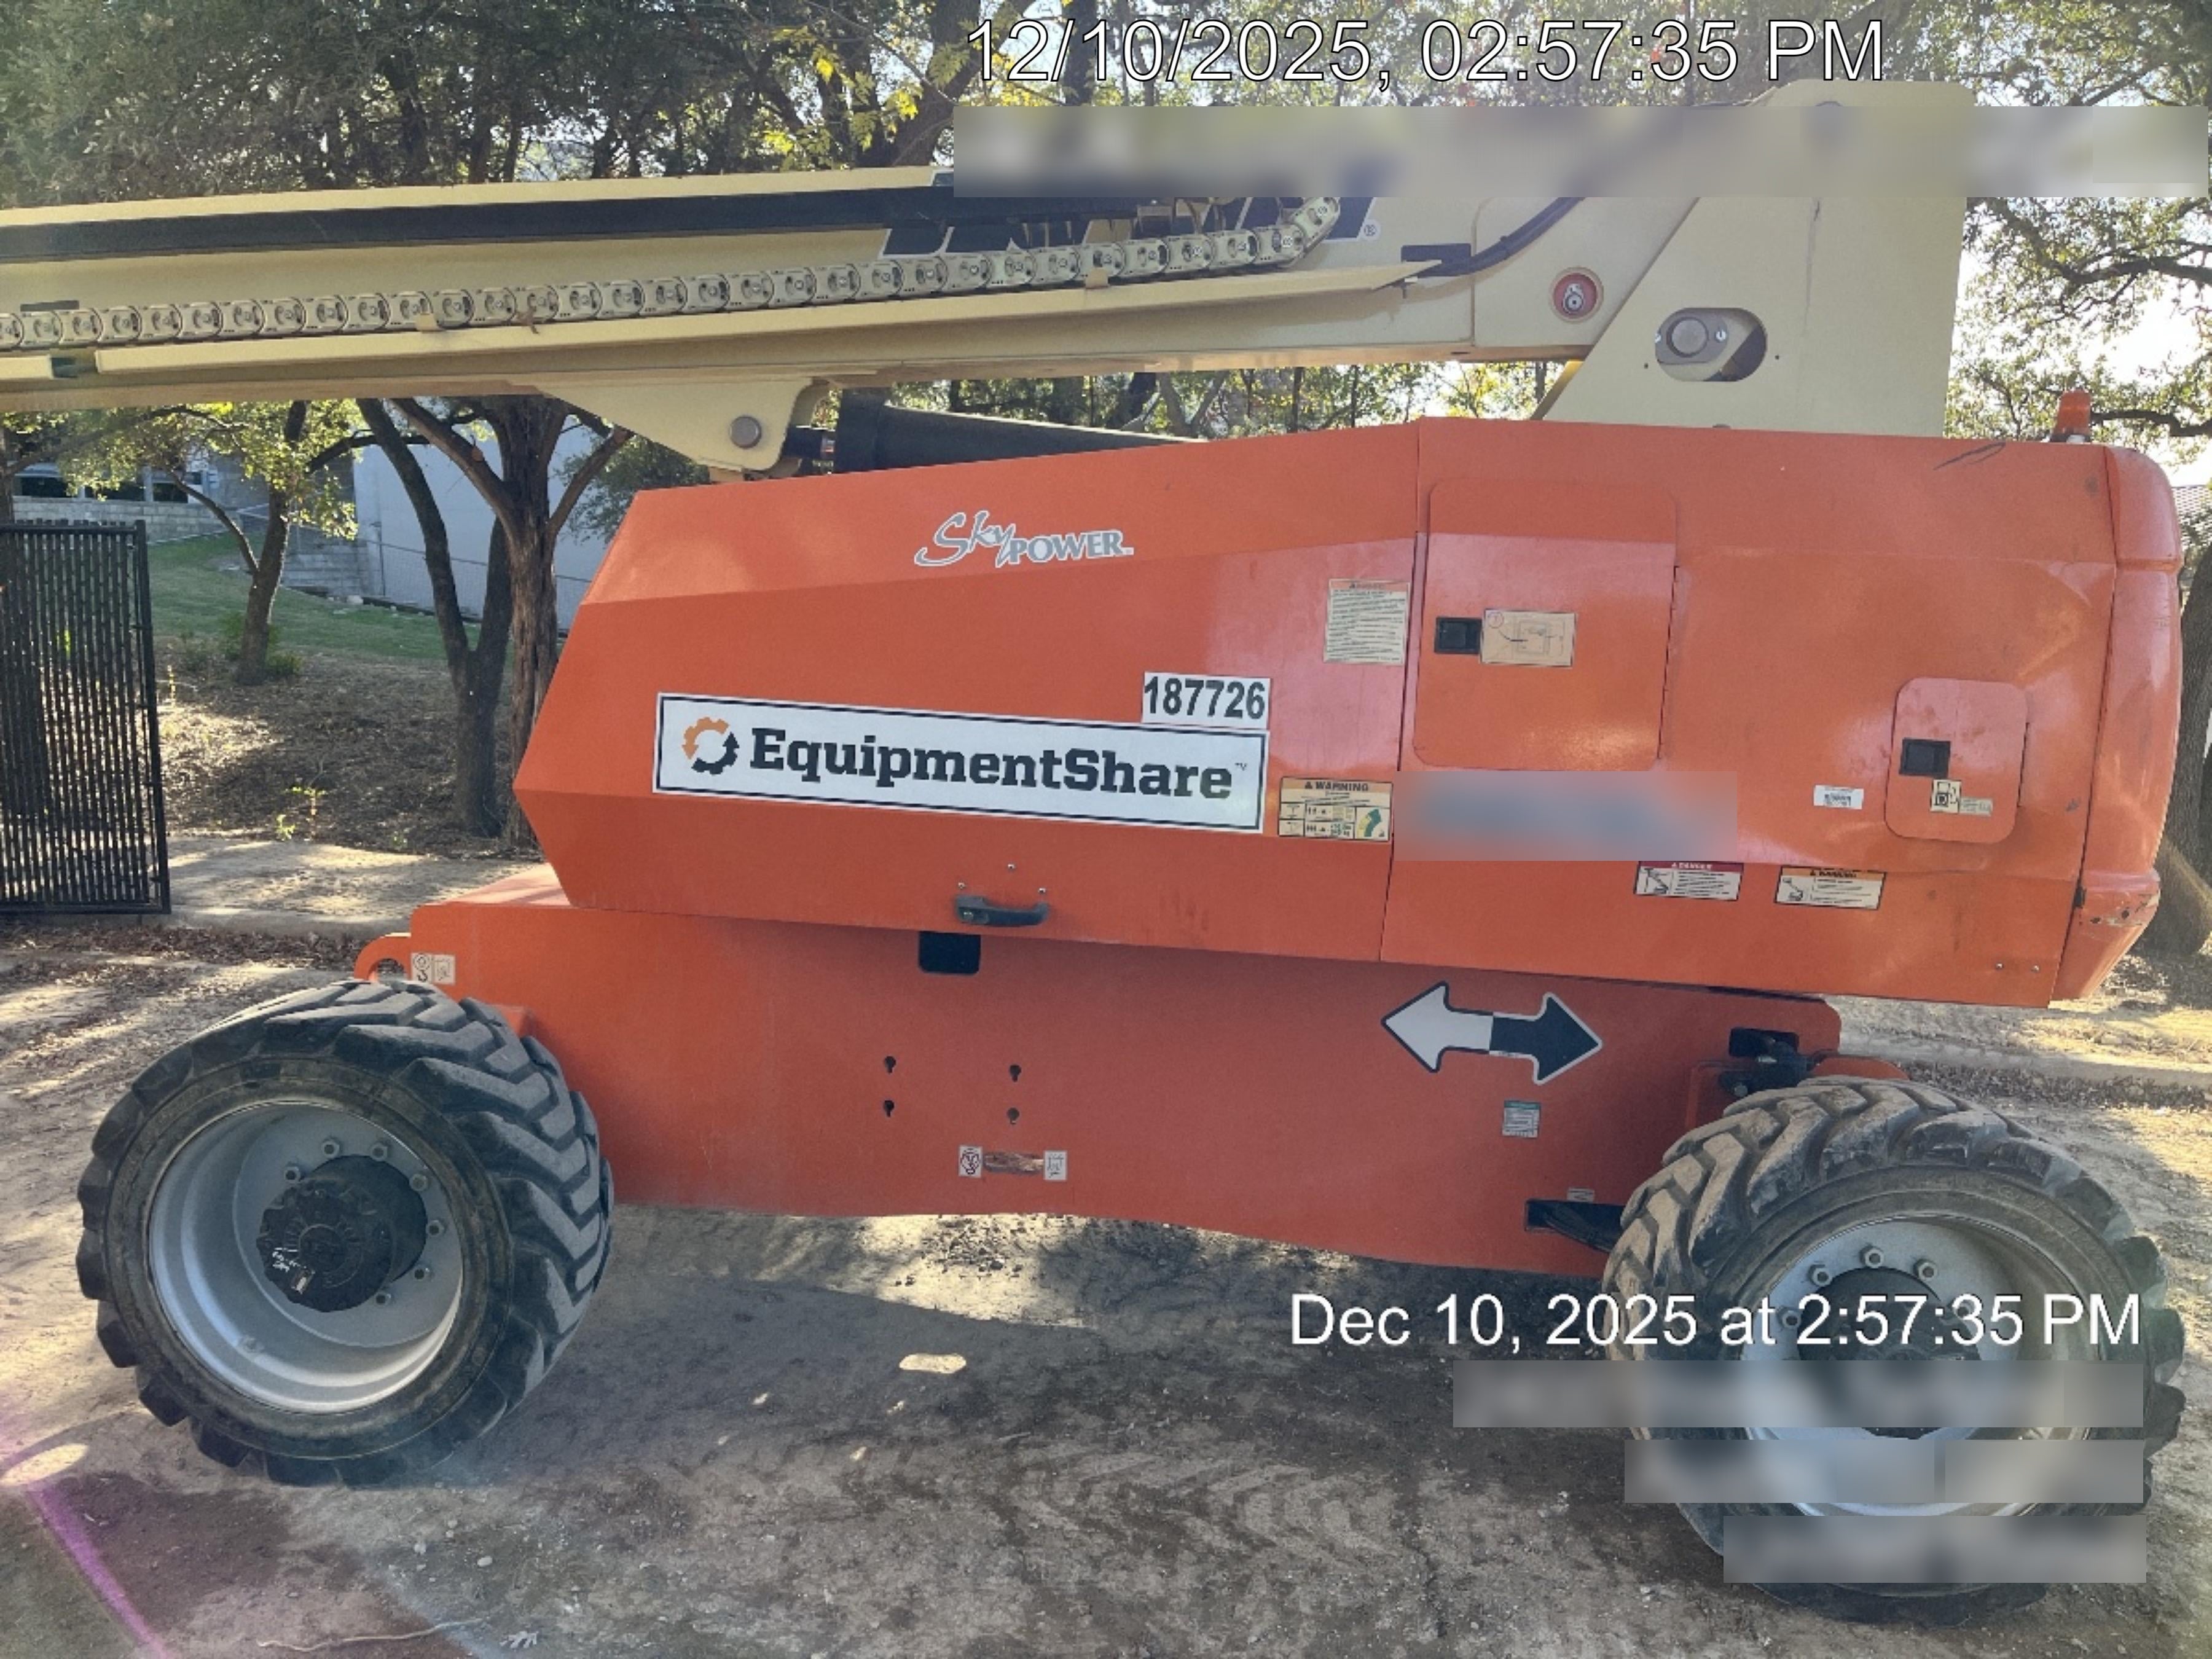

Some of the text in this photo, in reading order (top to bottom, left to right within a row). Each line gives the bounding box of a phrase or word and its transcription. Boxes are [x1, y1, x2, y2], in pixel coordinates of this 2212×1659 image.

[1143, 674, 1266, 720] 187726
[750, 728, 1234, 800] EquipmentShare
[1316, 781, 1369, 792] WARNING
